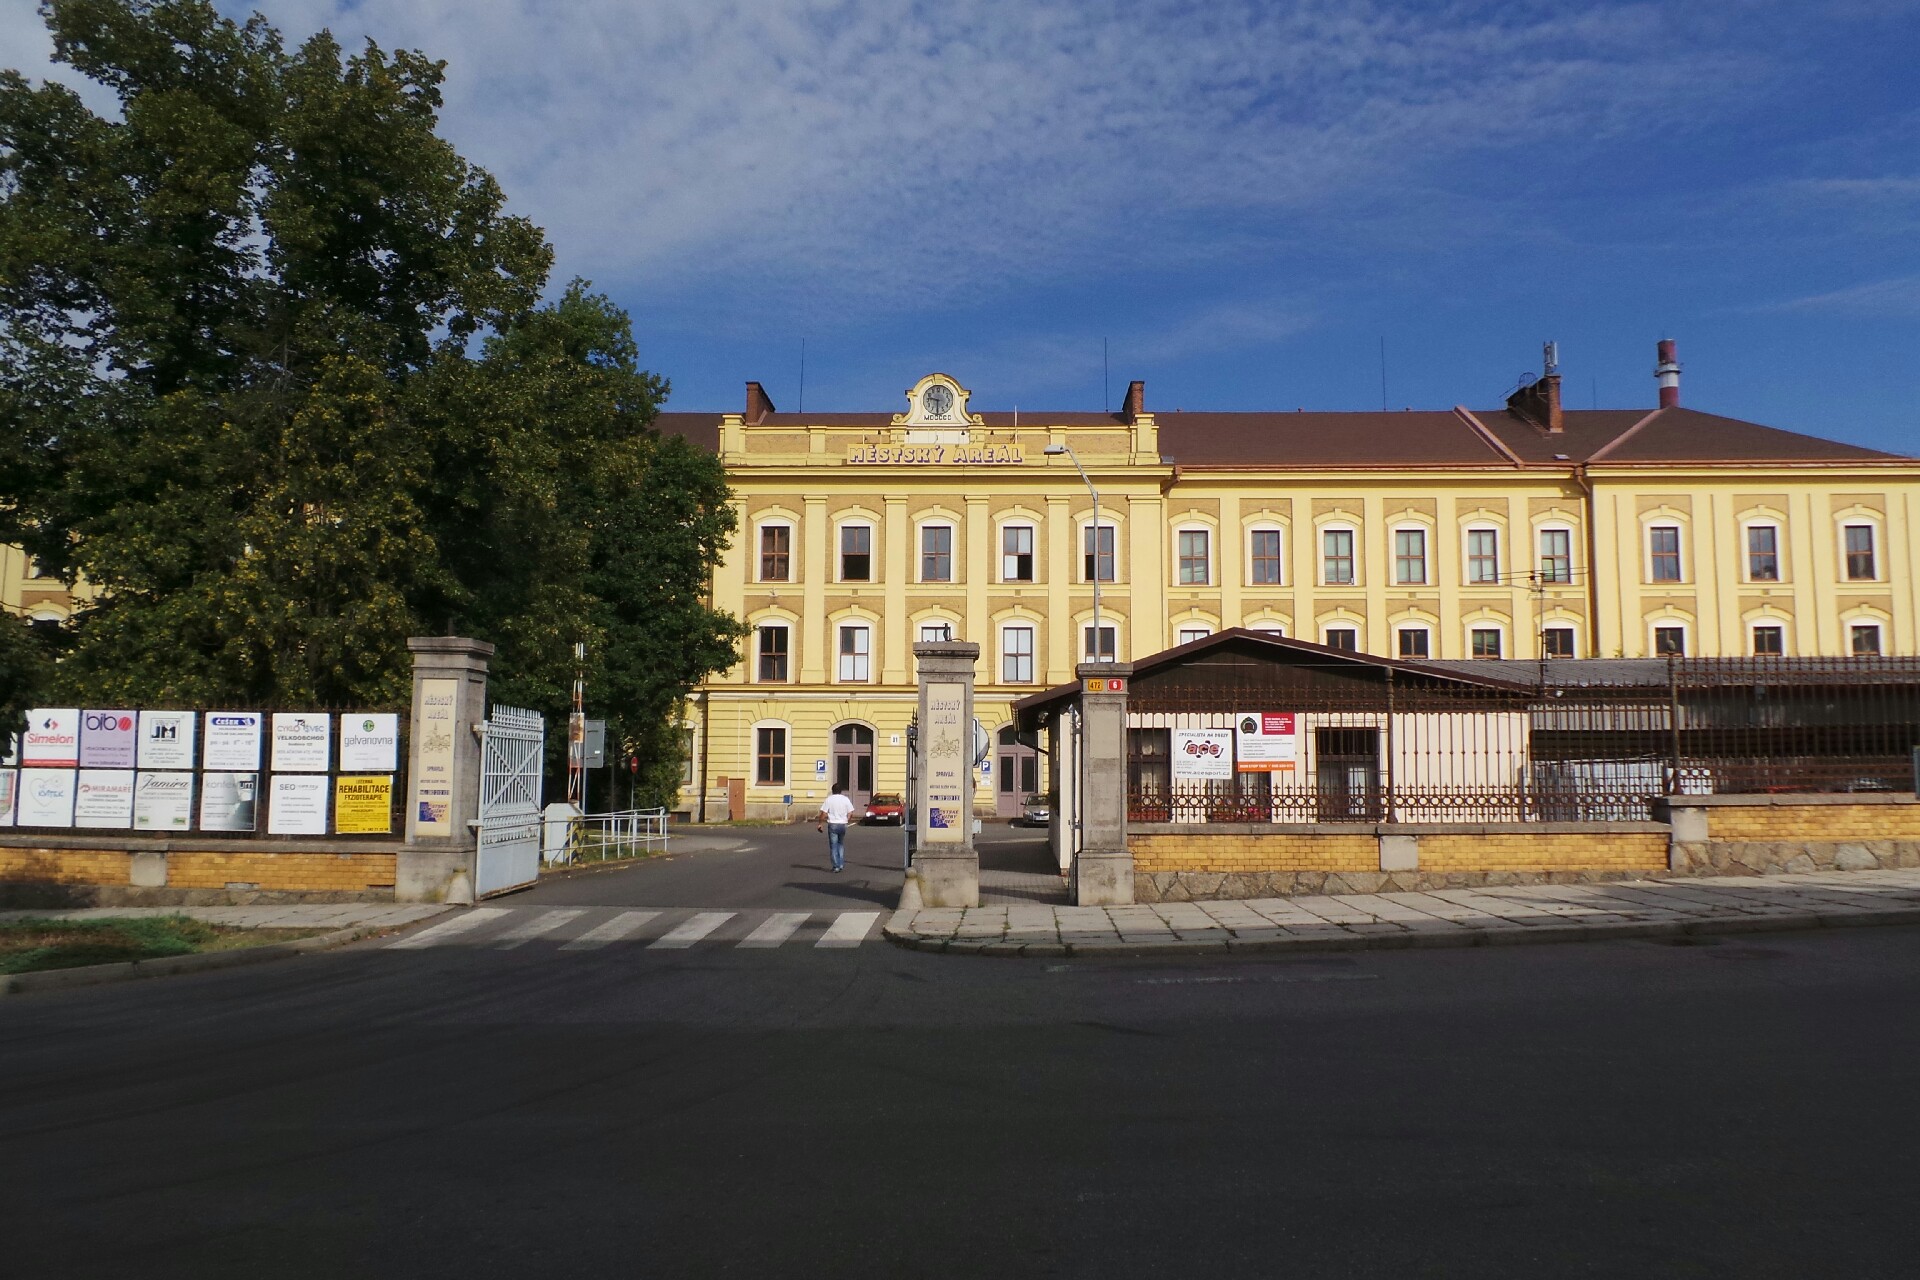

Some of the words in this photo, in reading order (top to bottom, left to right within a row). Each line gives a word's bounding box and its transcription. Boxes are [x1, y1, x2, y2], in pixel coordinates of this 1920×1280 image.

[849, 445, 945, 463] MĚSTSKÝ
[952, 445, 1023, 463] AREÁL
[1090, 681, 1101, 689] 472
[1112, 681, 1118, 689] 6
[344, 734, 393, 747] galvanovna
[338, 785, 390, 793] REHABILITACE
